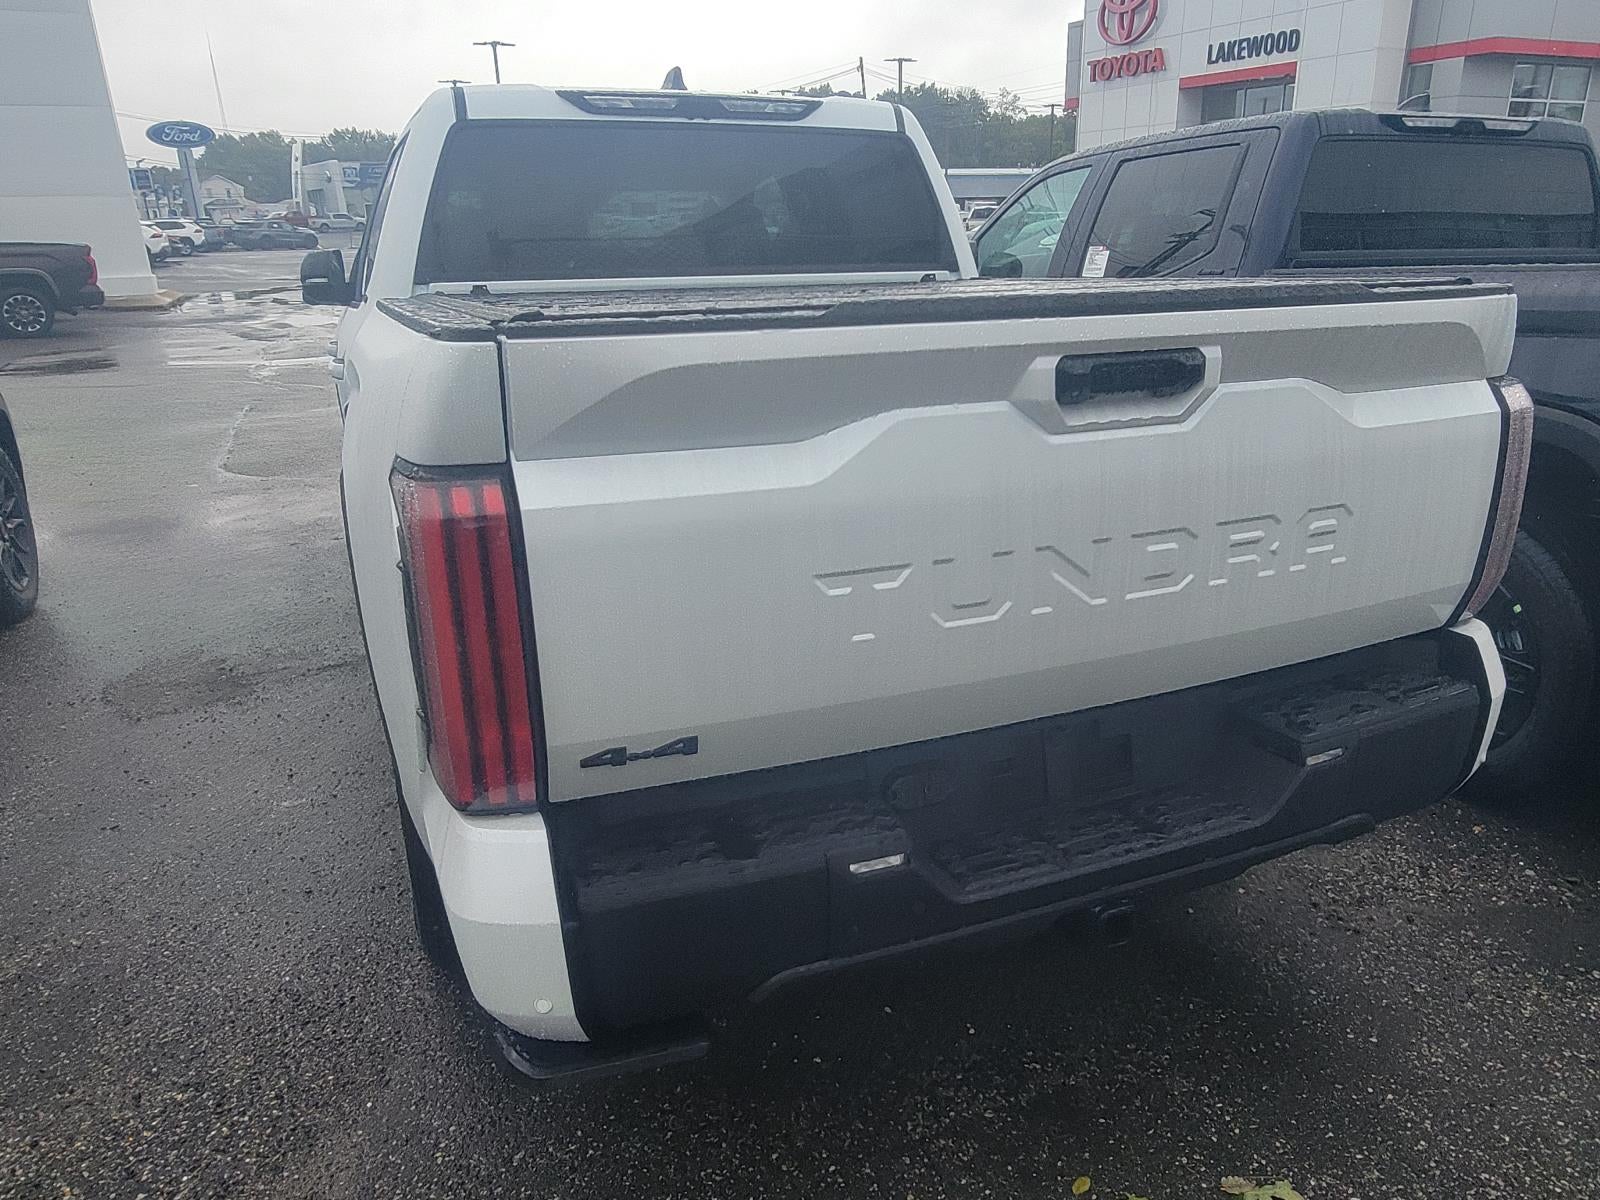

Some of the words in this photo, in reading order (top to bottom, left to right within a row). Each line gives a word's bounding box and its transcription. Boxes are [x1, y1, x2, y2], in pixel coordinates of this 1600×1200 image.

[1087, 47, 1167, 82] TOYOTA
[1206, 28, 1301, 65] LAKEWOOD
[161, 125, 201, 142] Ford
[813, 503, 1354, 642] TUNDRA
